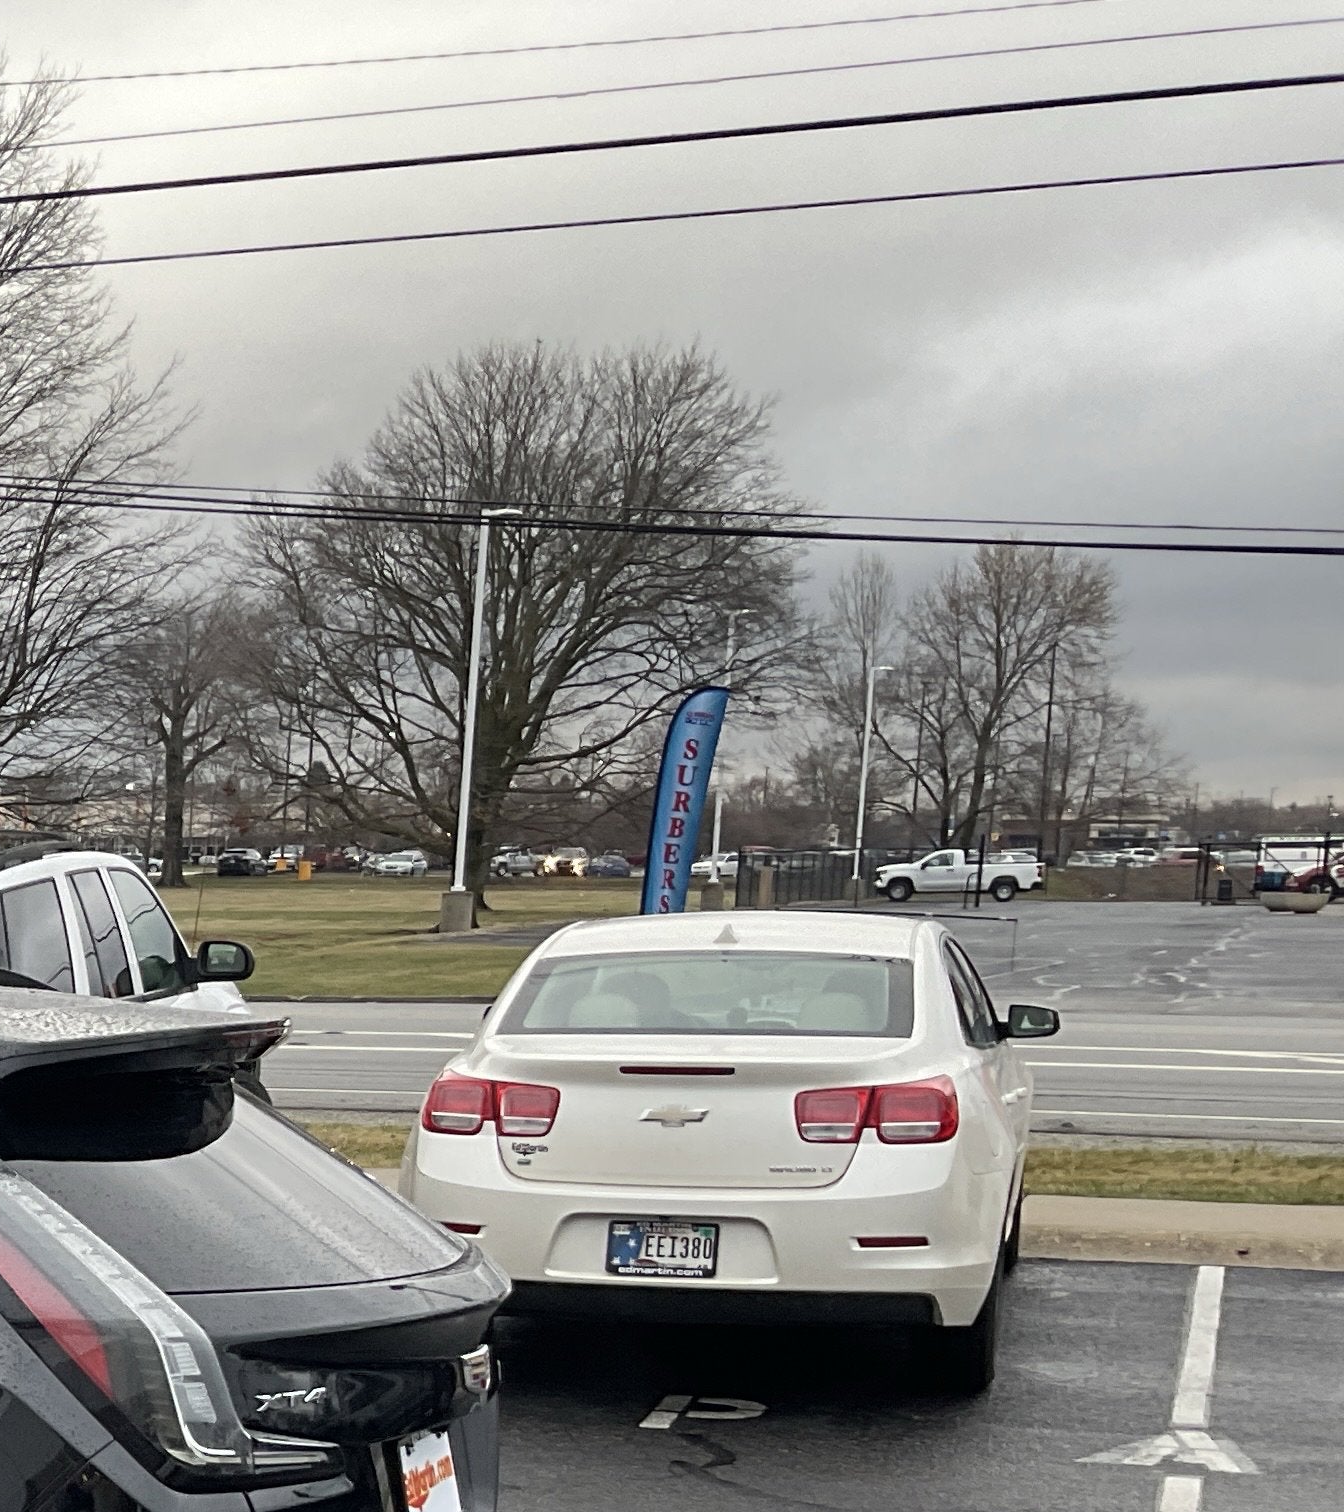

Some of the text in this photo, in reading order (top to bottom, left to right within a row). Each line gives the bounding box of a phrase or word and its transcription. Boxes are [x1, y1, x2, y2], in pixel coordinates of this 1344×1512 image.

[658, 738, 700, 913] SURBERS
[645, 1235, 713, 1259] EEI380
[254, 1386, 327, 1412] XT4
